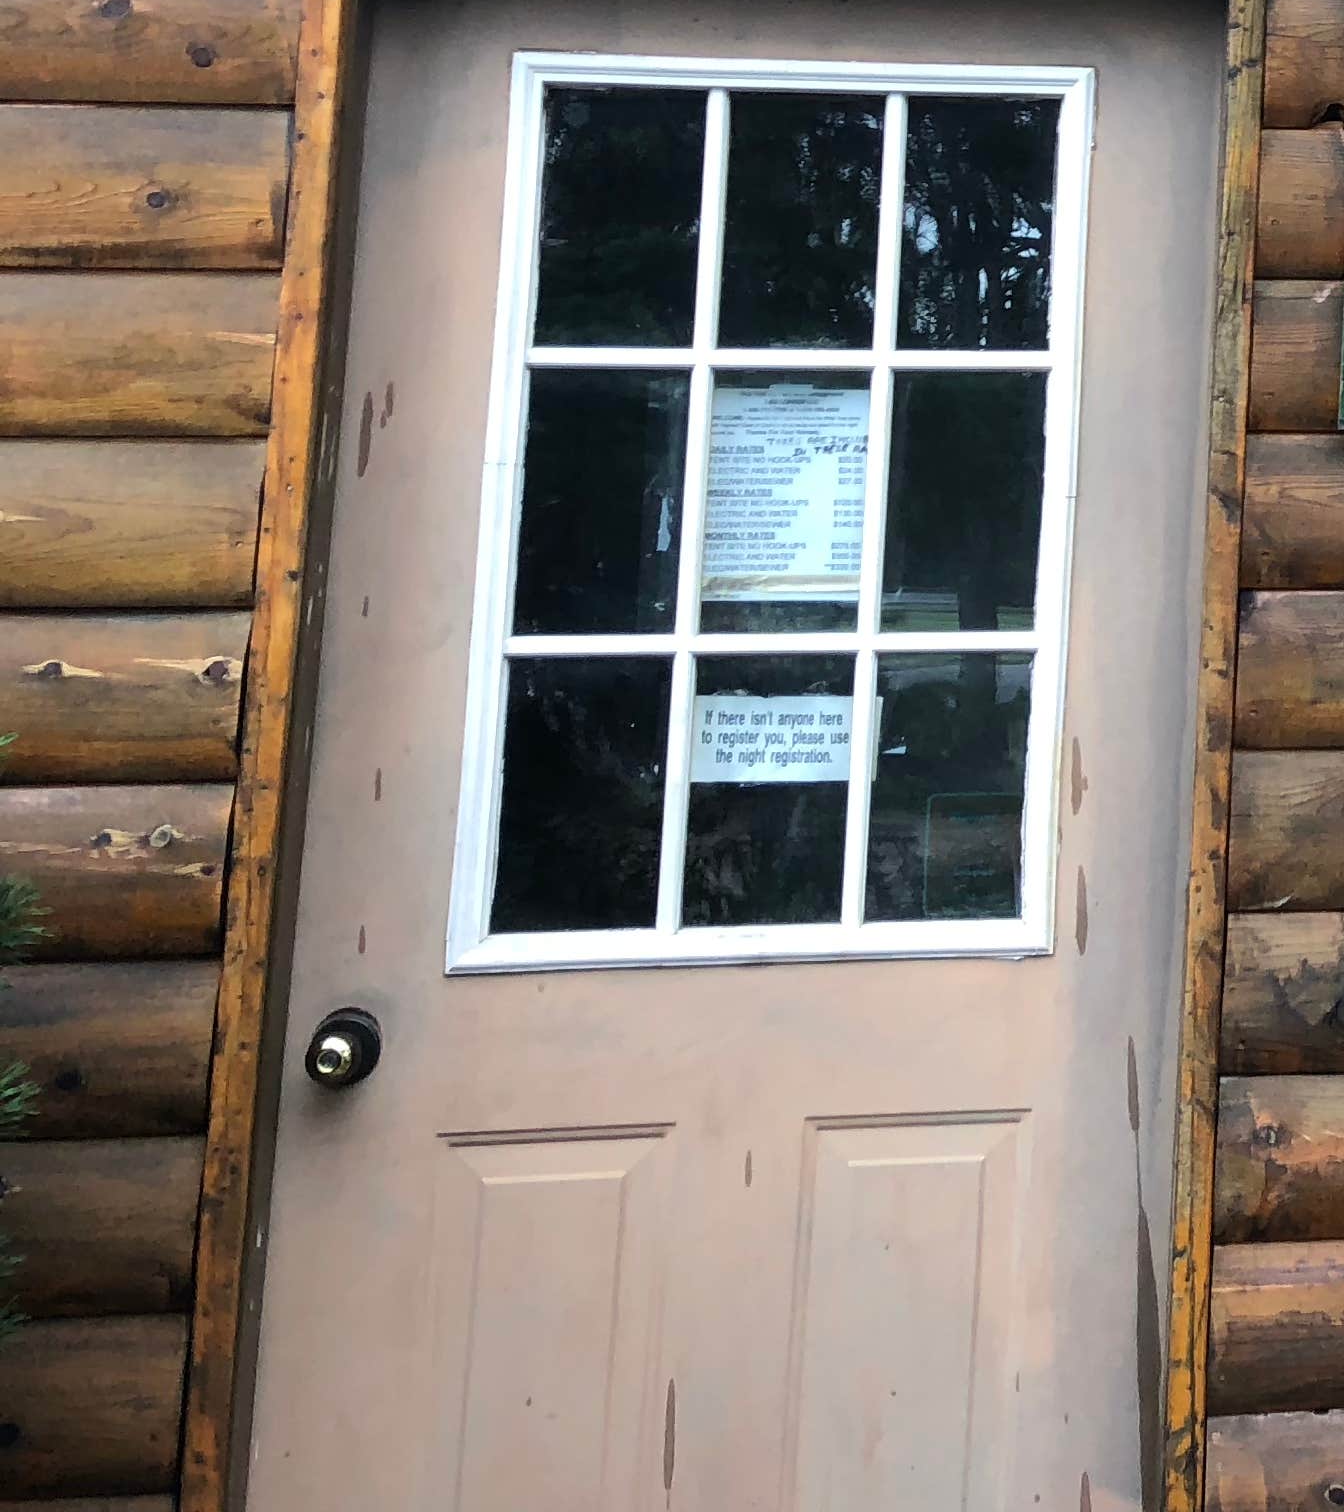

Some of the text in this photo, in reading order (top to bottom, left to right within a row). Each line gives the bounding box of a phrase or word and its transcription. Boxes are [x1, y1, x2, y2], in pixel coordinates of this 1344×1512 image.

[705, 709, 843, 729] If there isn't anyone here
[702, 730, 849, 747] to register you, please use
[716, 748, 832, 767] the night registration.
